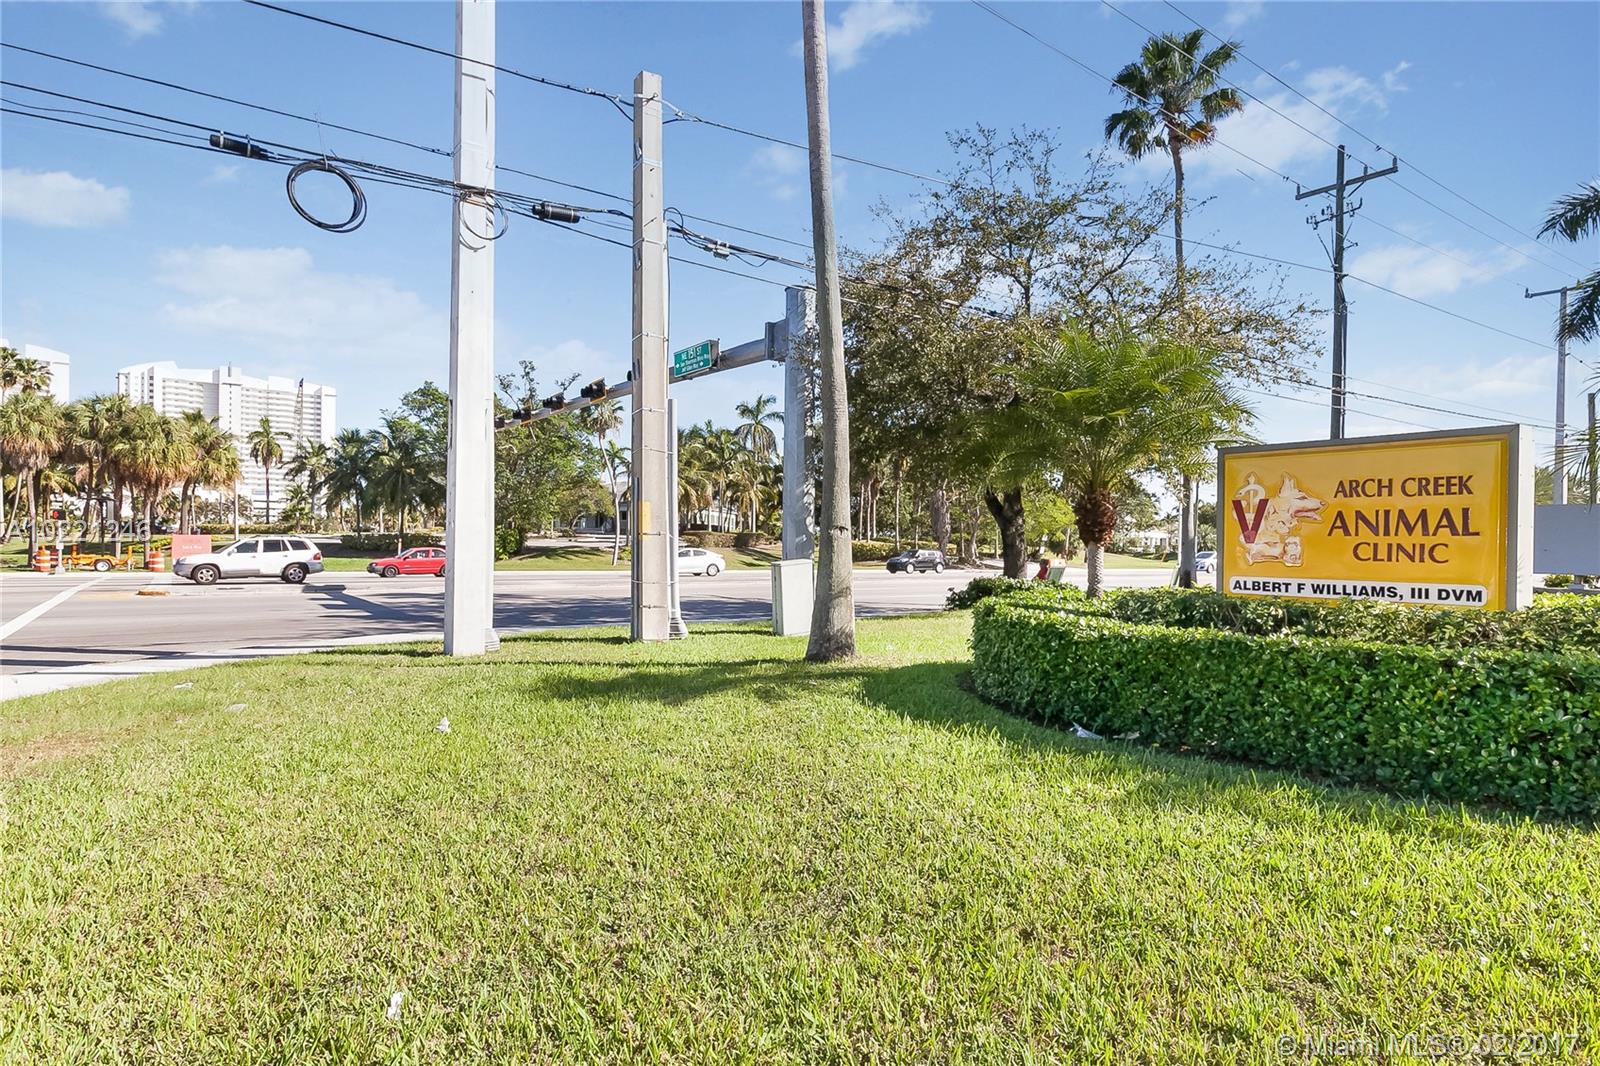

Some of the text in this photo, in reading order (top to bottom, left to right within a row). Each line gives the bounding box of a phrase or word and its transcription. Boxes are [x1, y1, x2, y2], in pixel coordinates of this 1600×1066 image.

[681, 352, 687, 360] NE
[687, 347, 696, 359] 151
[1334, 475, 1474, 498] ARCH CREEK
[1327, 507, 1481, 537] ANIMAL
[1352, 542, 1449, 564] CLINIC
[1233, 580, 1483, 603] ALBERT F WILLIAMS, III DVM
